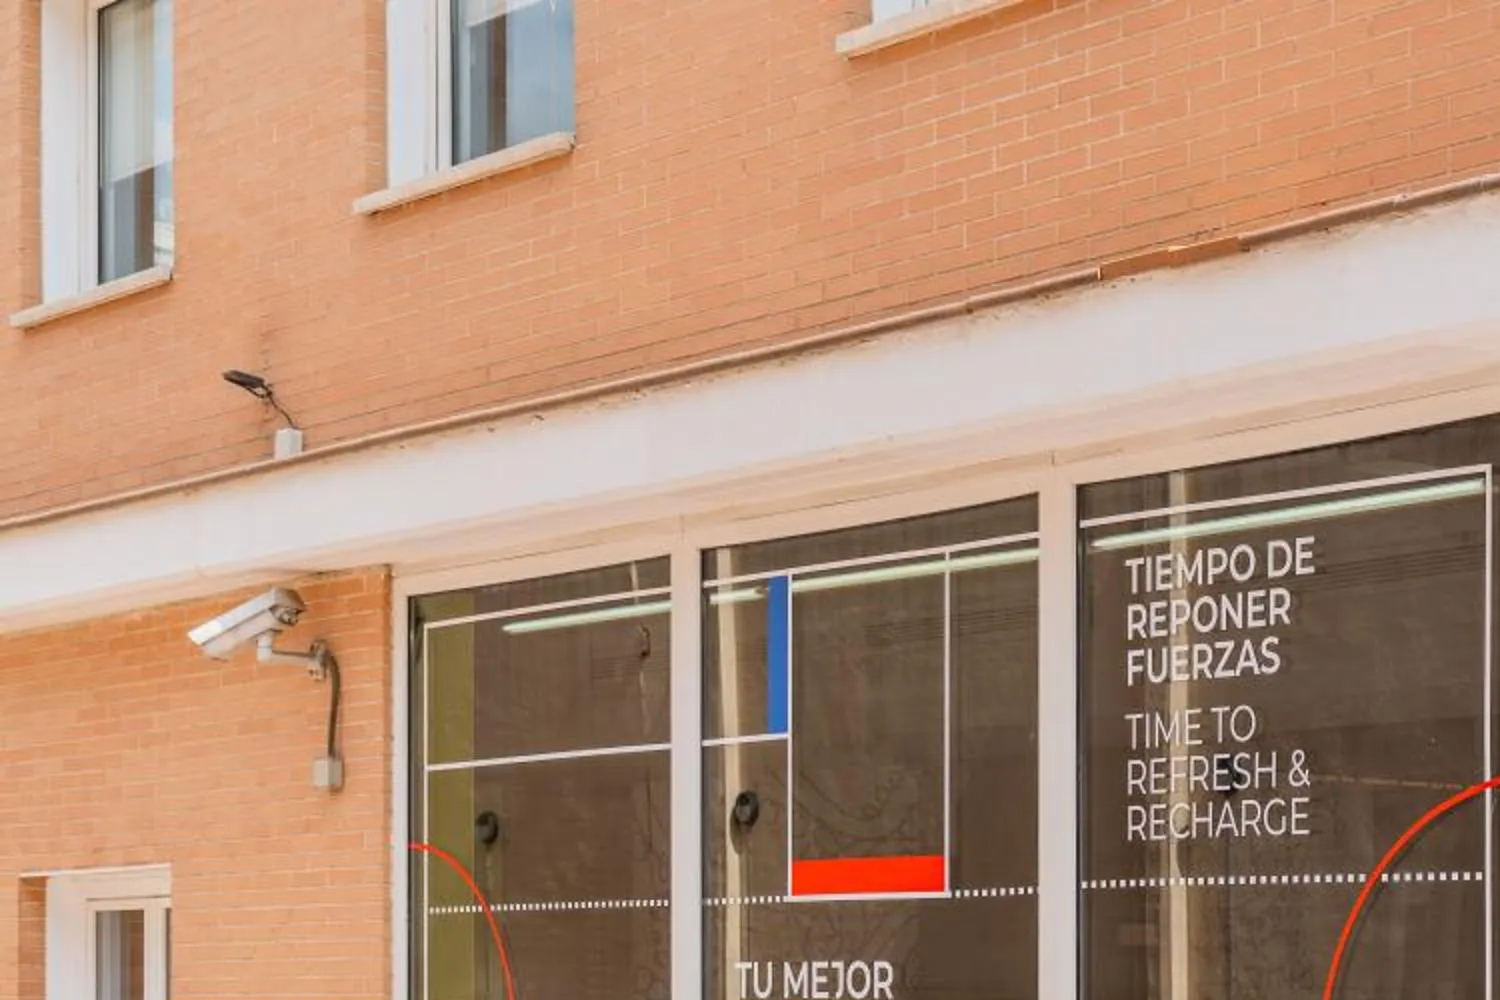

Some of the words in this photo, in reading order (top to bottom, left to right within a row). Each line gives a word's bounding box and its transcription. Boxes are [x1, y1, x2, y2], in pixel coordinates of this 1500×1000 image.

[1125, 544, 1257, 594] TIEMPO
[1267, 536, 1316, 579] DE
[1127, 587, 1291, 641] REPONER
[1127, 635, 1281, 687] FUERZAS
[1124, 707, 1204, 750] TIME
[1210, 704, 1257, 743] TO
[1127, 750, 1277, 796] REFRESH
[1288, 749, 1311, 788] &
[1127, 797, 1311, 841] RECHARGE
[734, 960, 774, 1000] TU
[783, 960, 894, 1000] MEJOR
